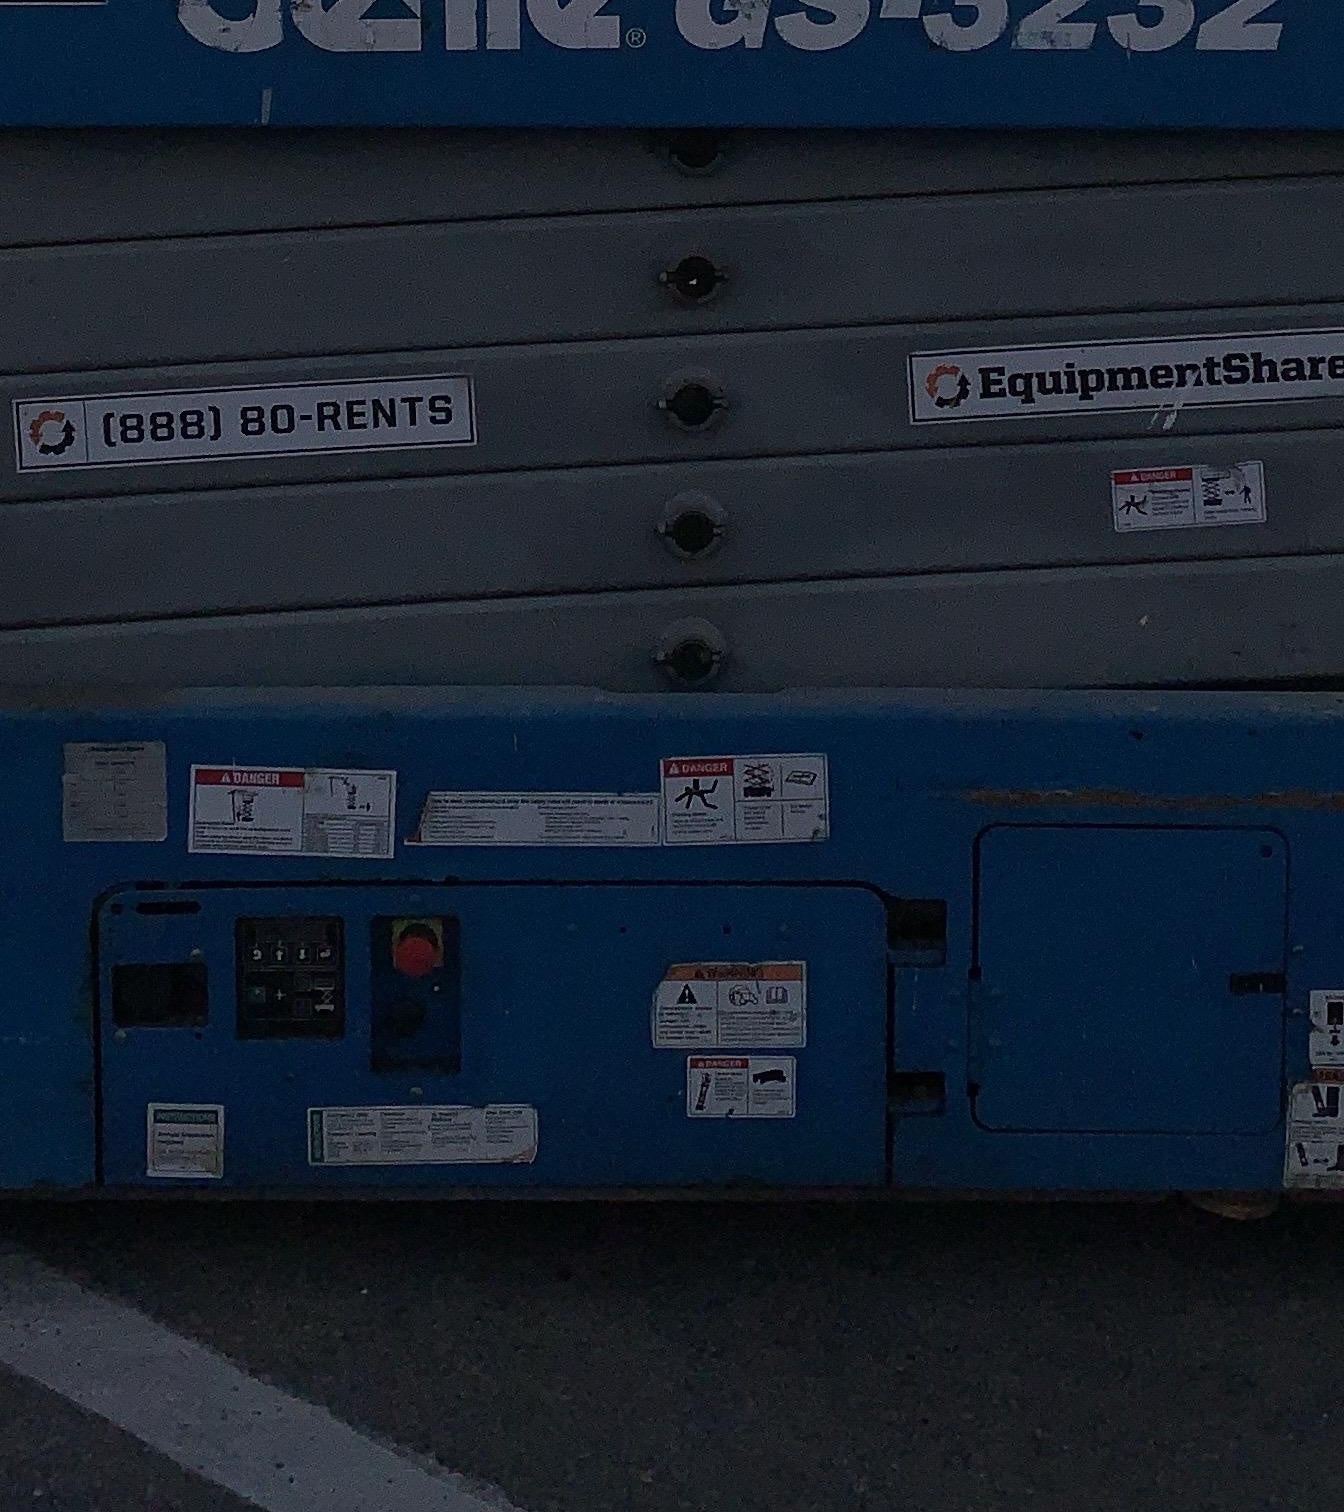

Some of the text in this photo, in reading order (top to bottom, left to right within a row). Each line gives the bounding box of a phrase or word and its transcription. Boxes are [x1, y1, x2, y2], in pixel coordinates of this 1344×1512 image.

[102, 393, 454, 448] (888) 80-RENTS
[1140, 470, 1177, 483] DANGER
[681, 761, 729, 774] DANGER
[232, 771, 281, 786] DANGER
